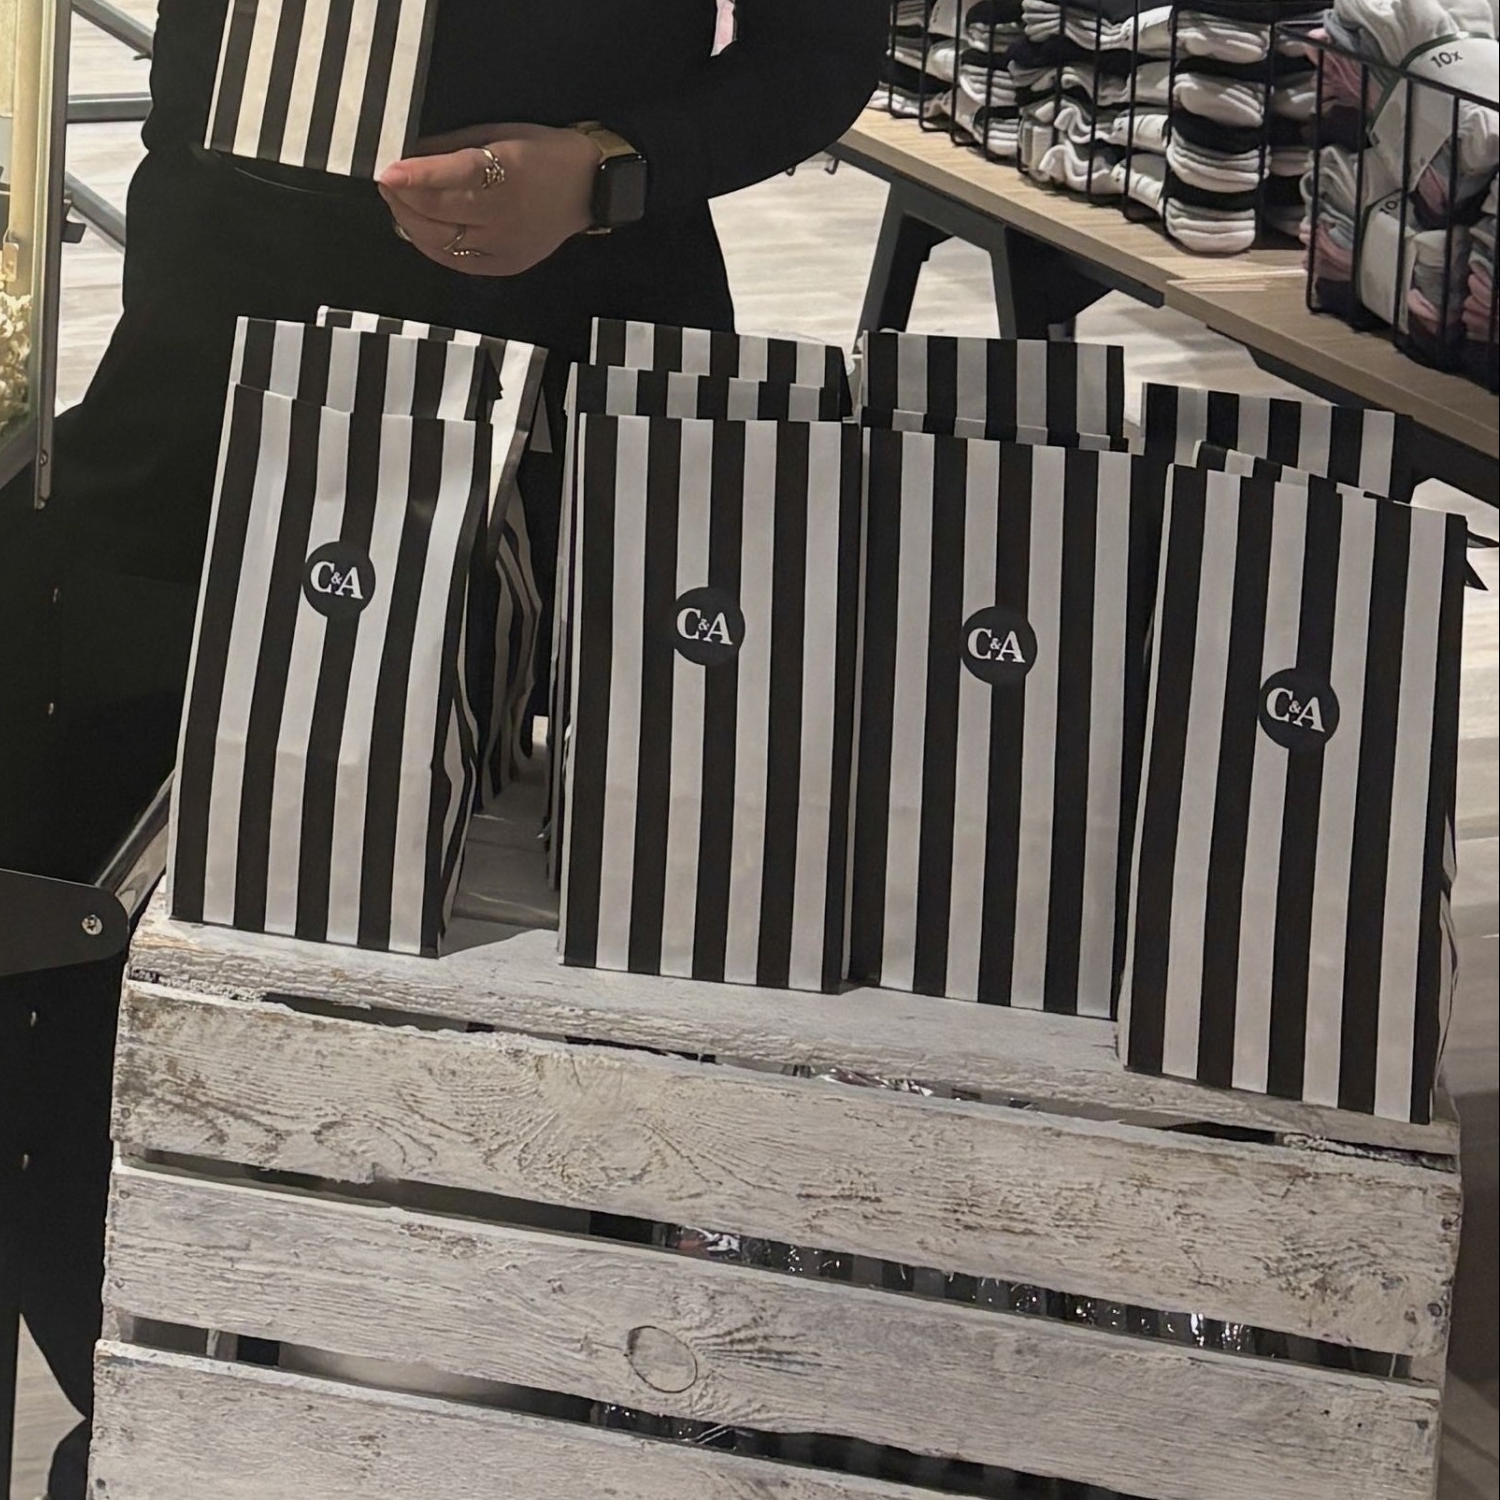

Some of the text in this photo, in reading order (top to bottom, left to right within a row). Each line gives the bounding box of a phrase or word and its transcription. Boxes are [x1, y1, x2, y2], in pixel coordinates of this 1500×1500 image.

[1430, 50, 1464, 68] 10x
[310, 561, 364, 599] C&A
[676, 607, 733, 646] C&A
[967, 627, 1026, 663] C&A
[1266, 687, 1325, 733] C&A
